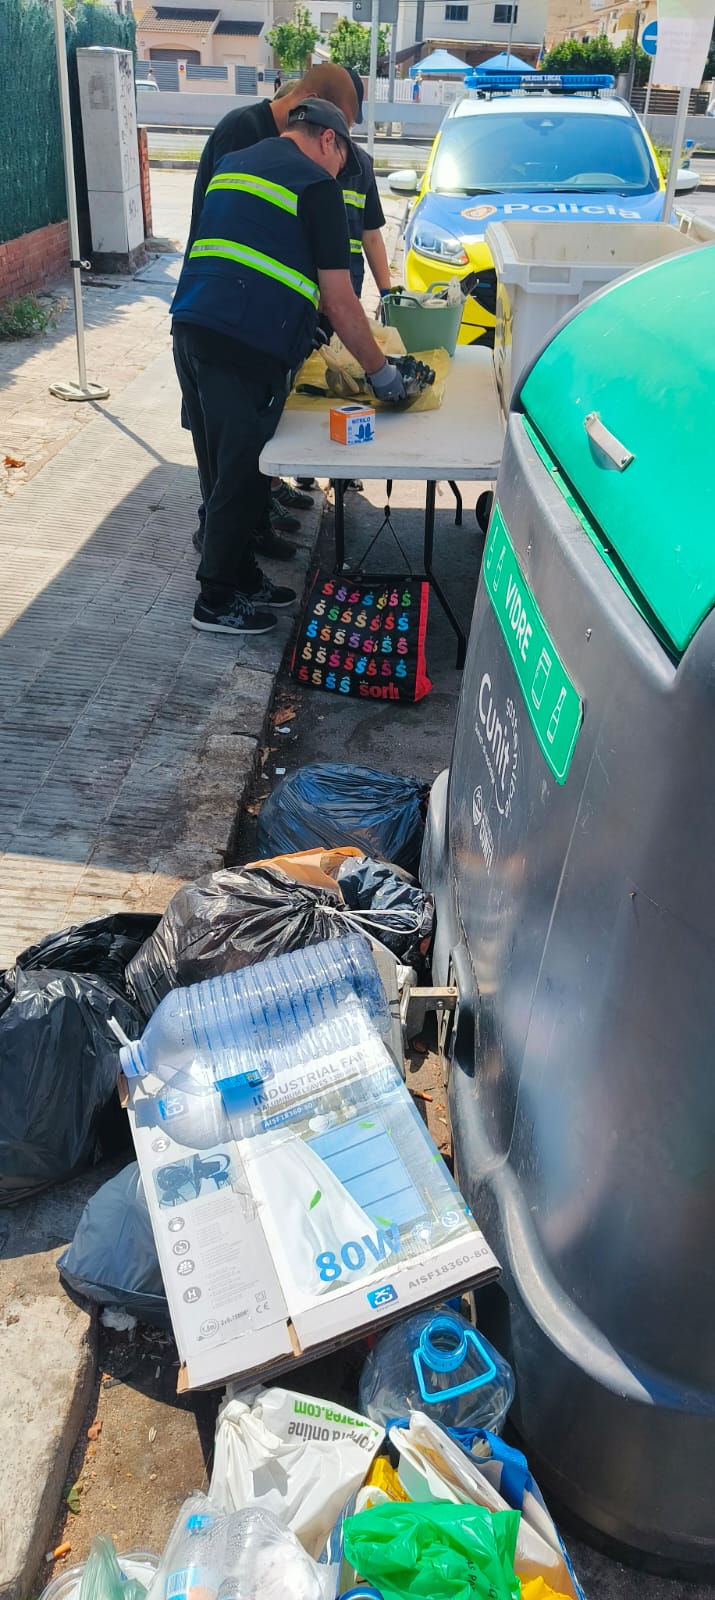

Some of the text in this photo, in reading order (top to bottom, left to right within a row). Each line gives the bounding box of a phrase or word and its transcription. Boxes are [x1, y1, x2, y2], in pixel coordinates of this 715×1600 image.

[505, 573, 533, 663] VIDRE
[359, 682, 399, 699] sorli
[478, 672, 510, 791] Cunit
[253, 1063, 337, 1105] INDUSTRIAL
[342, 1050, 369, 1068] FAN
[315, 1223, 401, 1282] 80W
[408, 1248, 489, 1289] AISF18360-80
[287, 1421, 330, 1442] online
